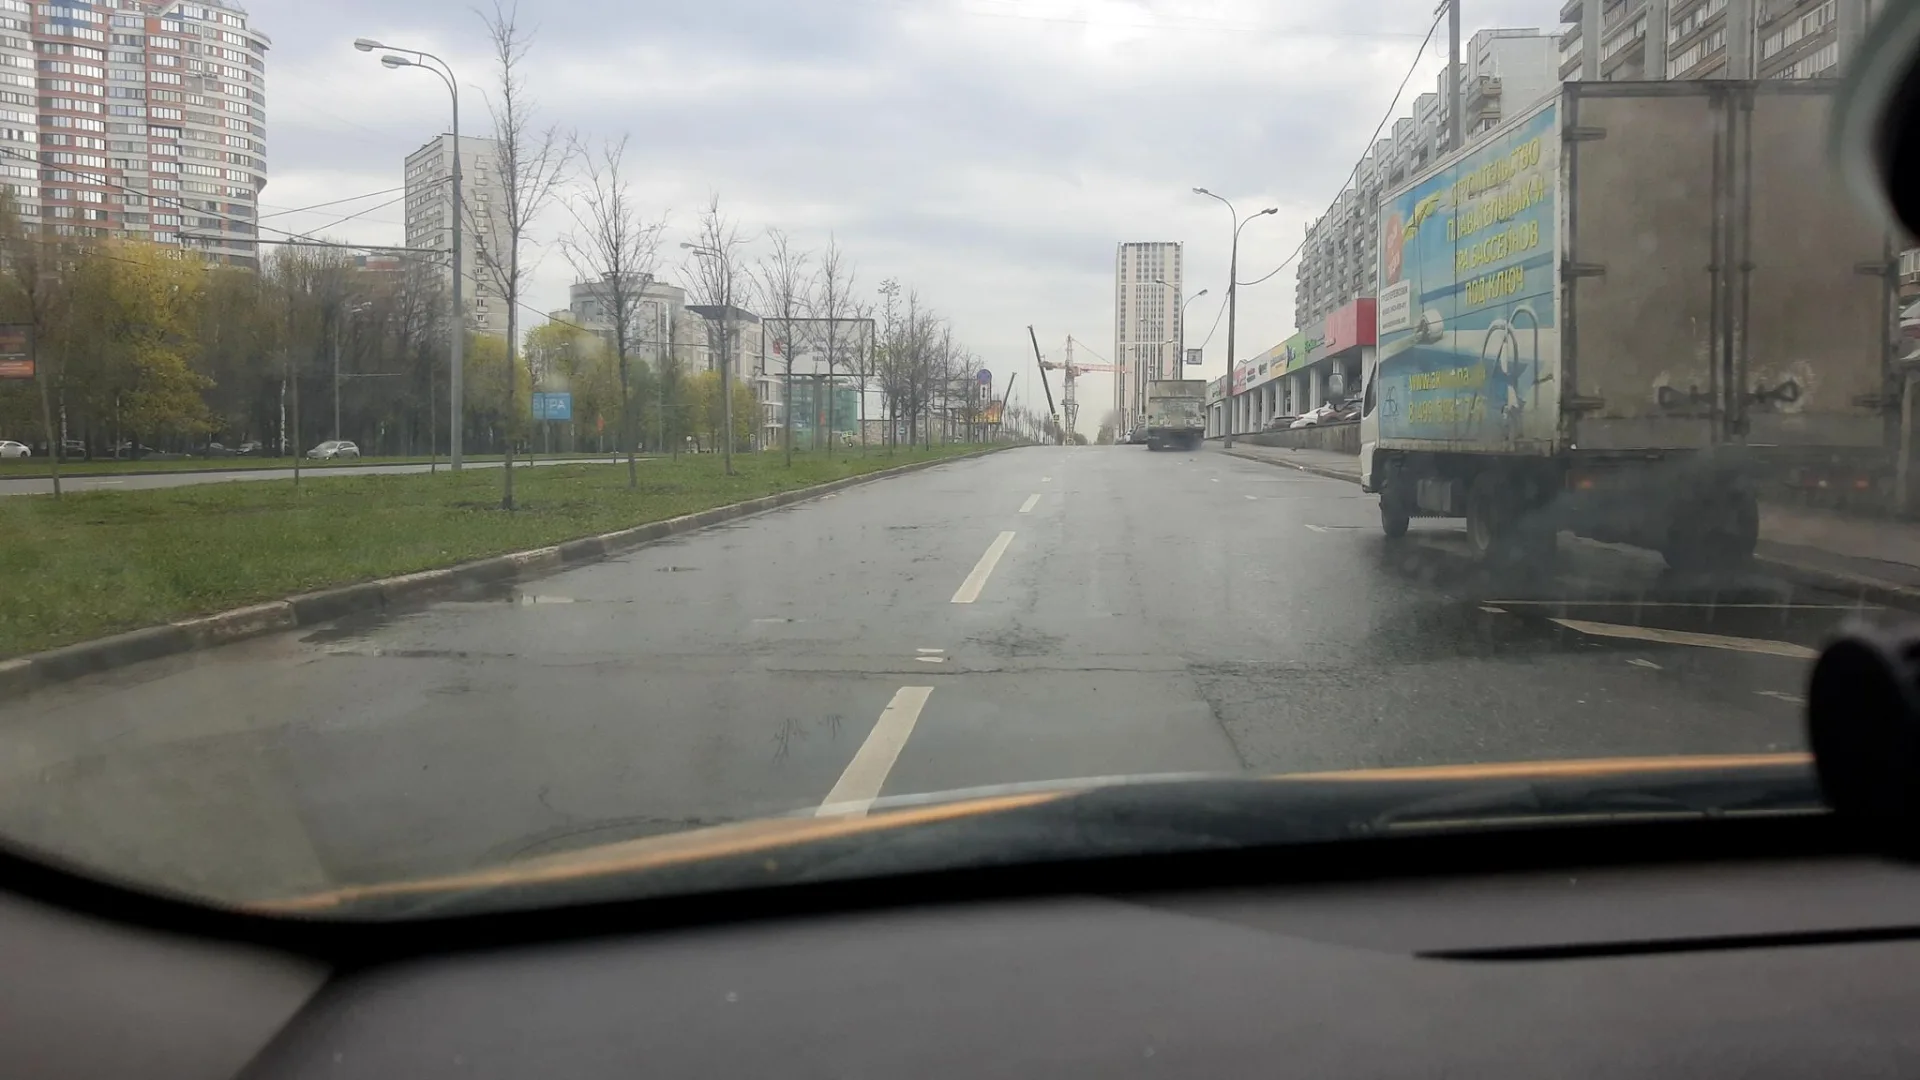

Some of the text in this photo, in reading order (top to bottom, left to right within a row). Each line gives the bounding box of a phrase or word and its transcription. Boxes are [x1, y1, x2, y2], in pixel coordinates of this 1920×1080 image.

[1452, 138, 1540, 207] СТРОИТЕЛЬСТВО
[1447, 178, 1532, 243] ПЛАВАТЕЛЬНЫХ
[1471, 219, 1539, 270] БАССЕЙНОВ
[1465, 264, 1525, 307] ПОД КЛЮЧ
